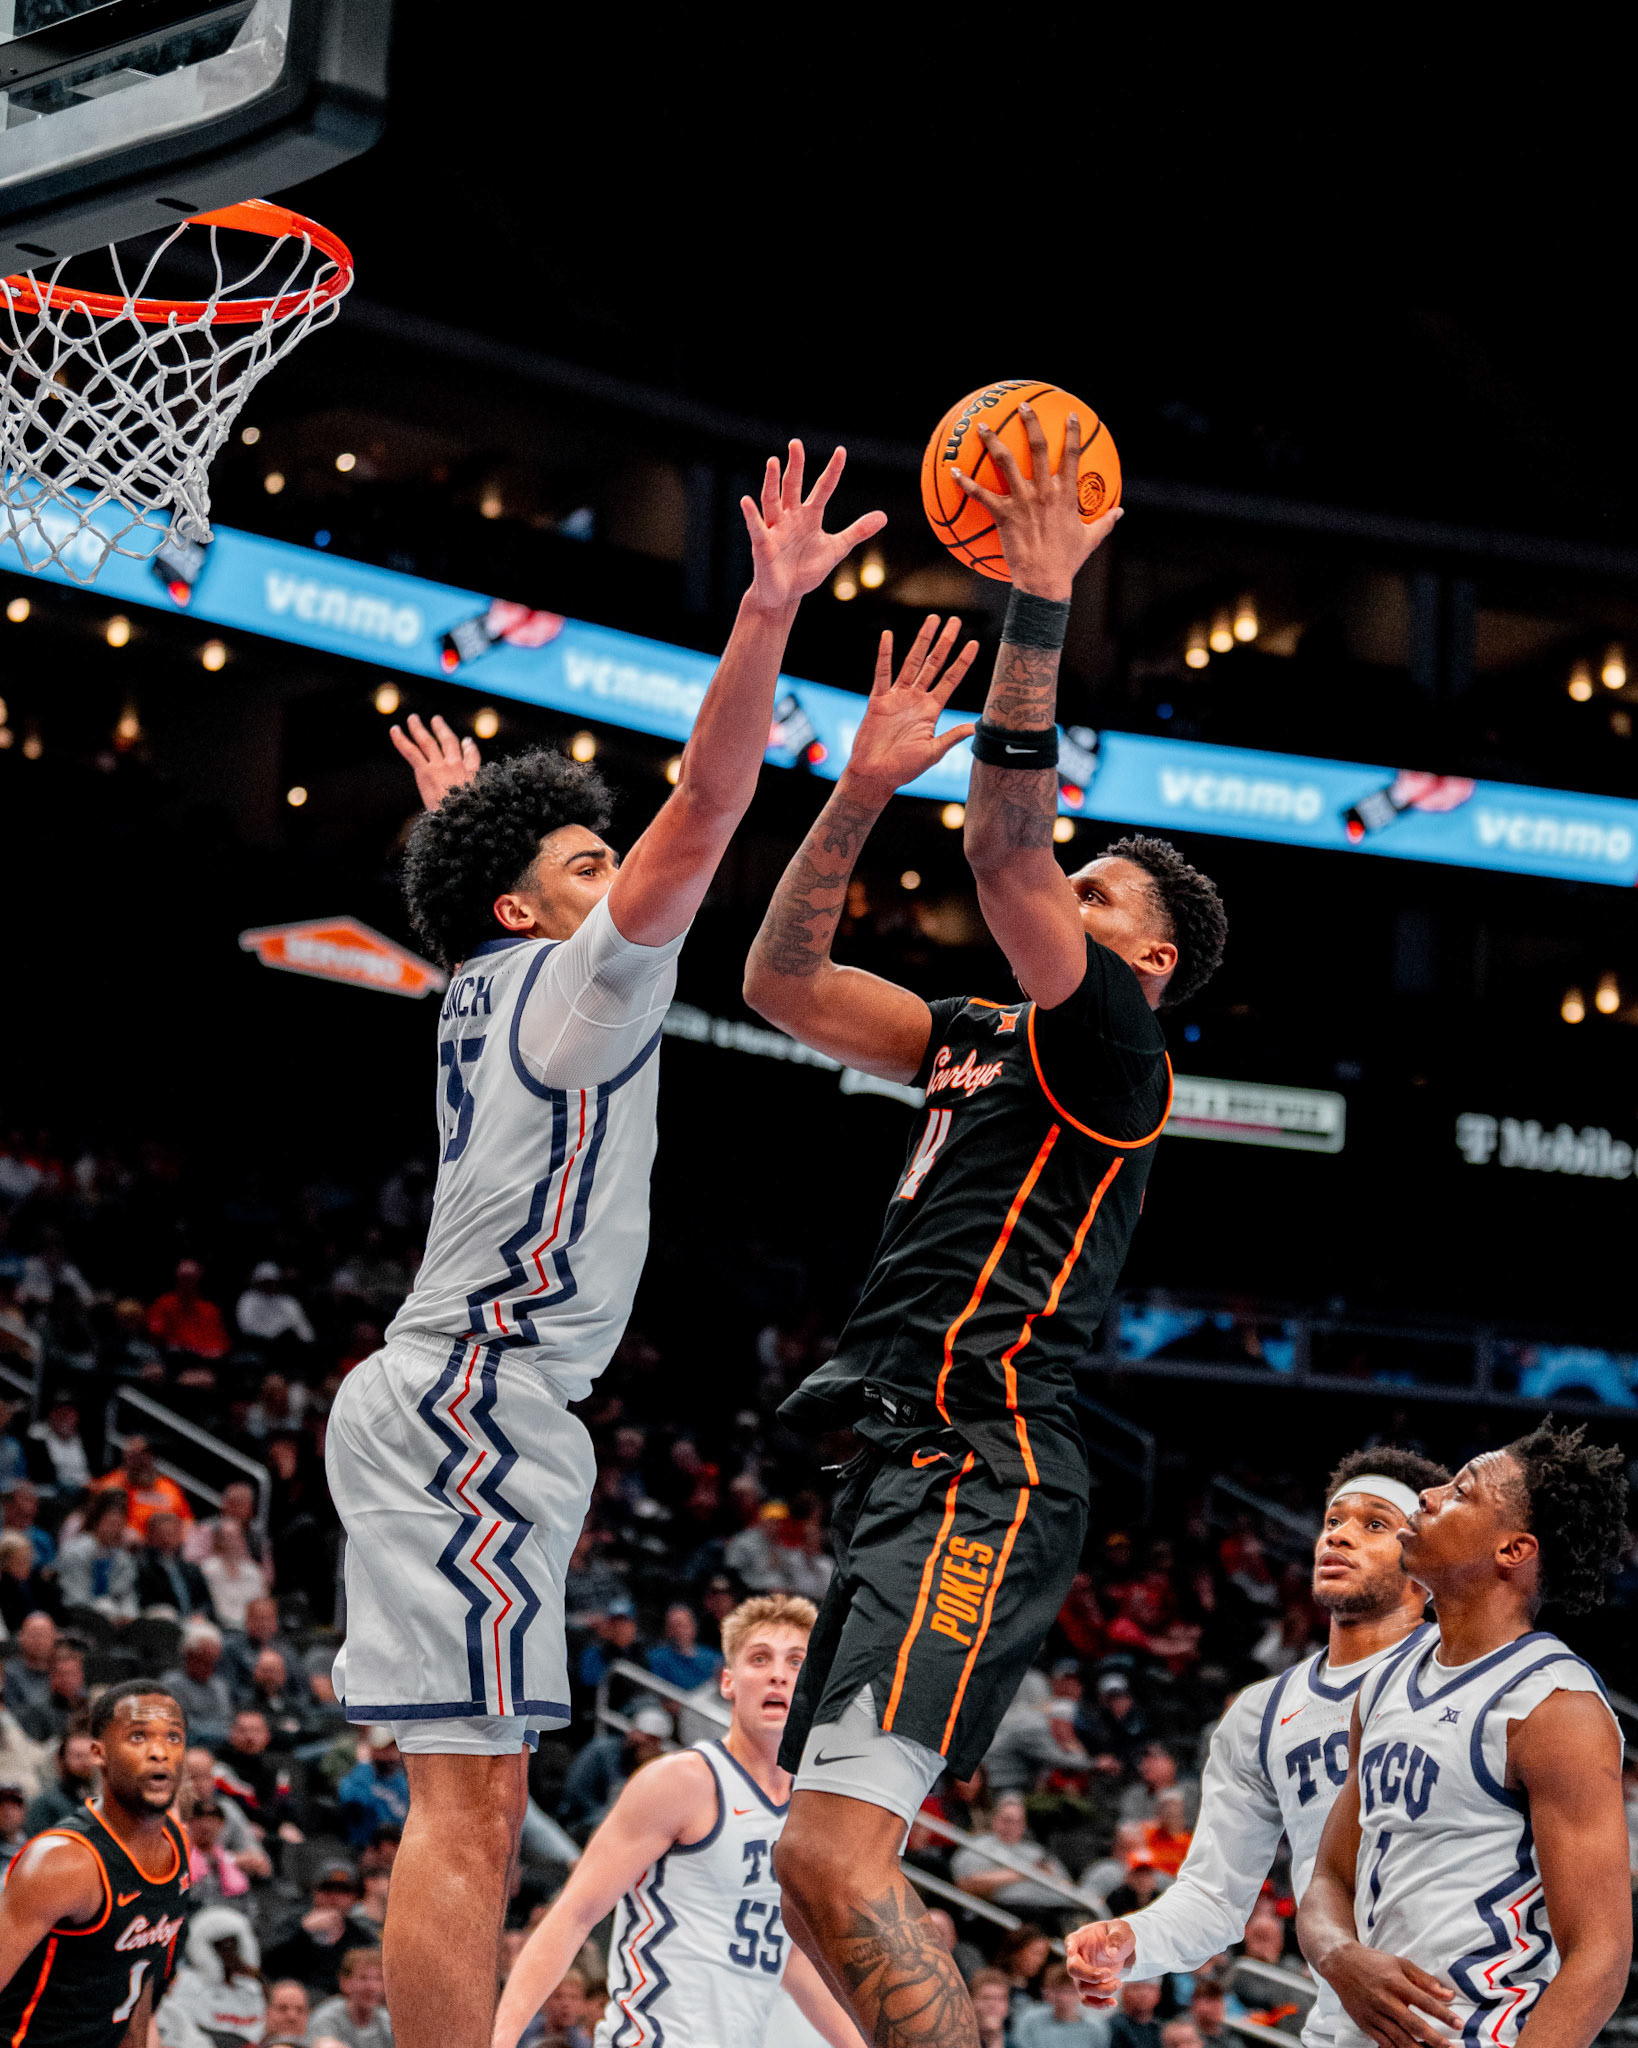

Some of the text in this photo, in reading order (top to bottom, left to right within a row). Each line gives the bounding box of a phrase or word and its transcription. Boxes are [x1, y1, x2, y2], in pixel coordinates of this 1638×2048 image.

[441, 976, 495, 1021] UNCH
[925, 1044, 1004, 1098] Cowboys
[1500, 1117, 1633, 1180] Mobile
[930, 1536, 994, 1646] POKES
[1361, 1742, 1440, 1822] TCU
[728, 1899, 783, 1975] 55
[112, 1959, 151, 2024] 1
